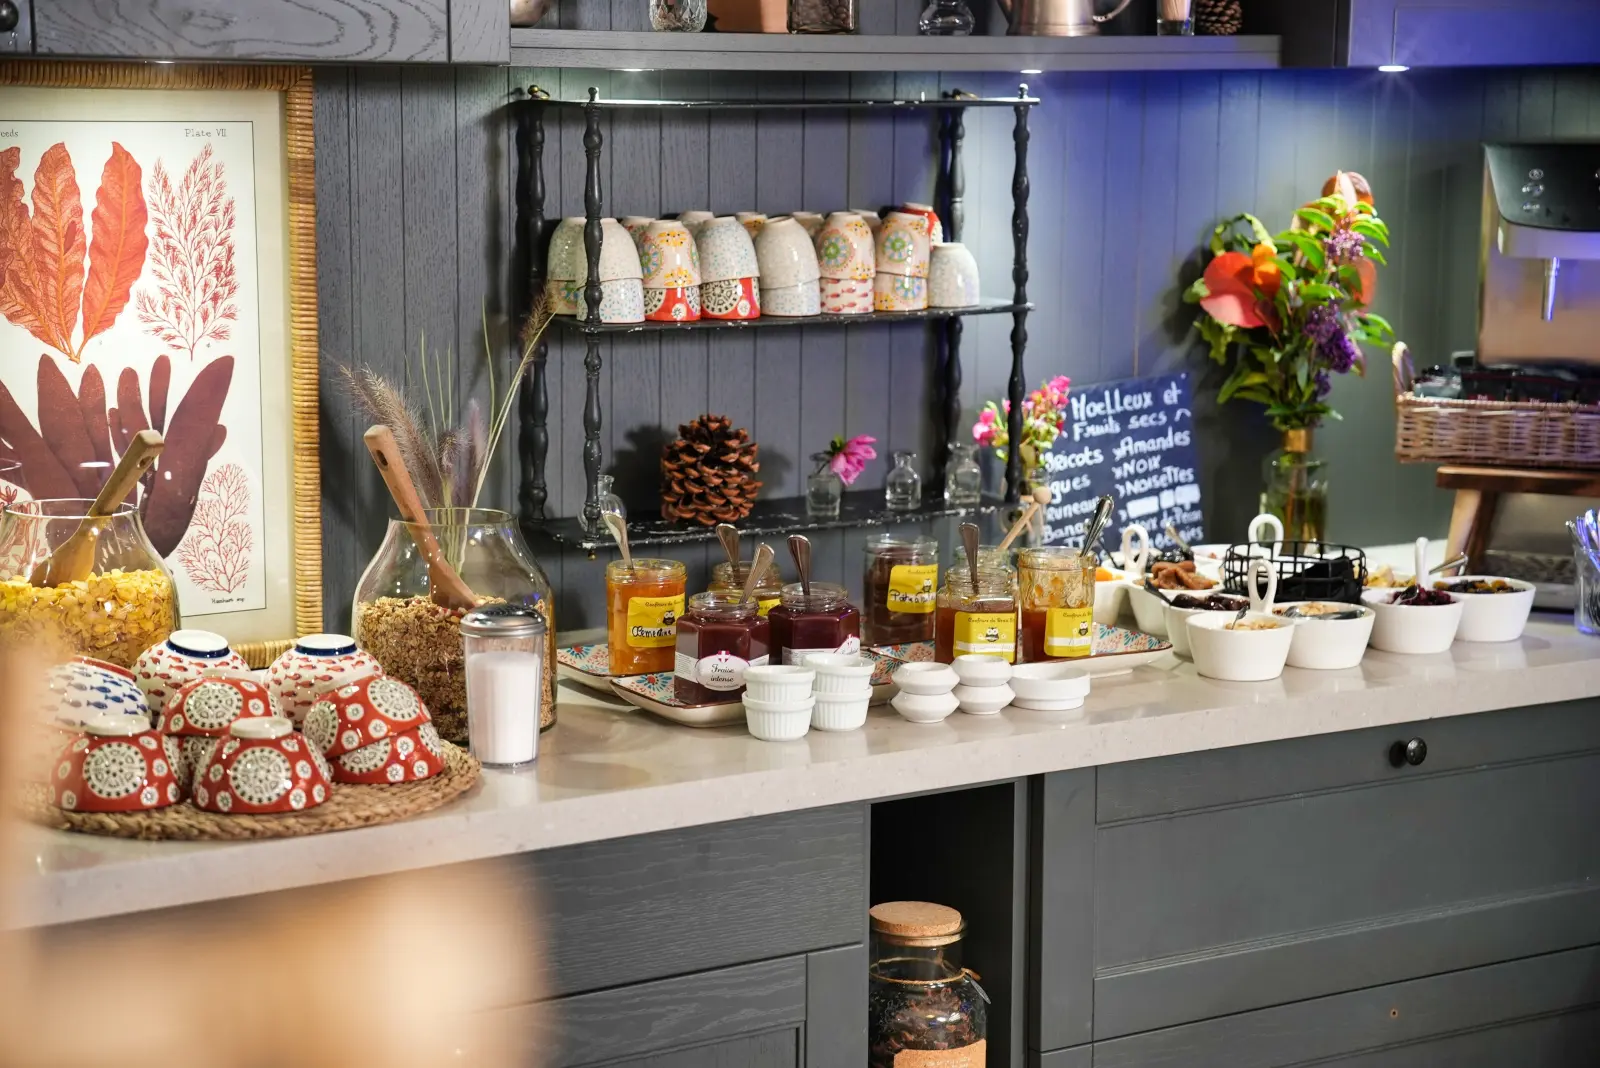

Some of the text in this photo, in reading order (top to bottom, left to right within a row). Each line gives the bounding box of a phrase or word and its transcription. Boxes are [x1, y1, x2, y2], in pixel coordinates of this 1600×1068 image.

[184, 128, 211, 138] Plate
[1163, 380, 1182, 406] et
[1127, 410, 1168, 430] secs
[1120, 425, 1191, 457] Amandes
[711, 663, 734, 673] Fraise
[710, 675, 734, 683] intense
